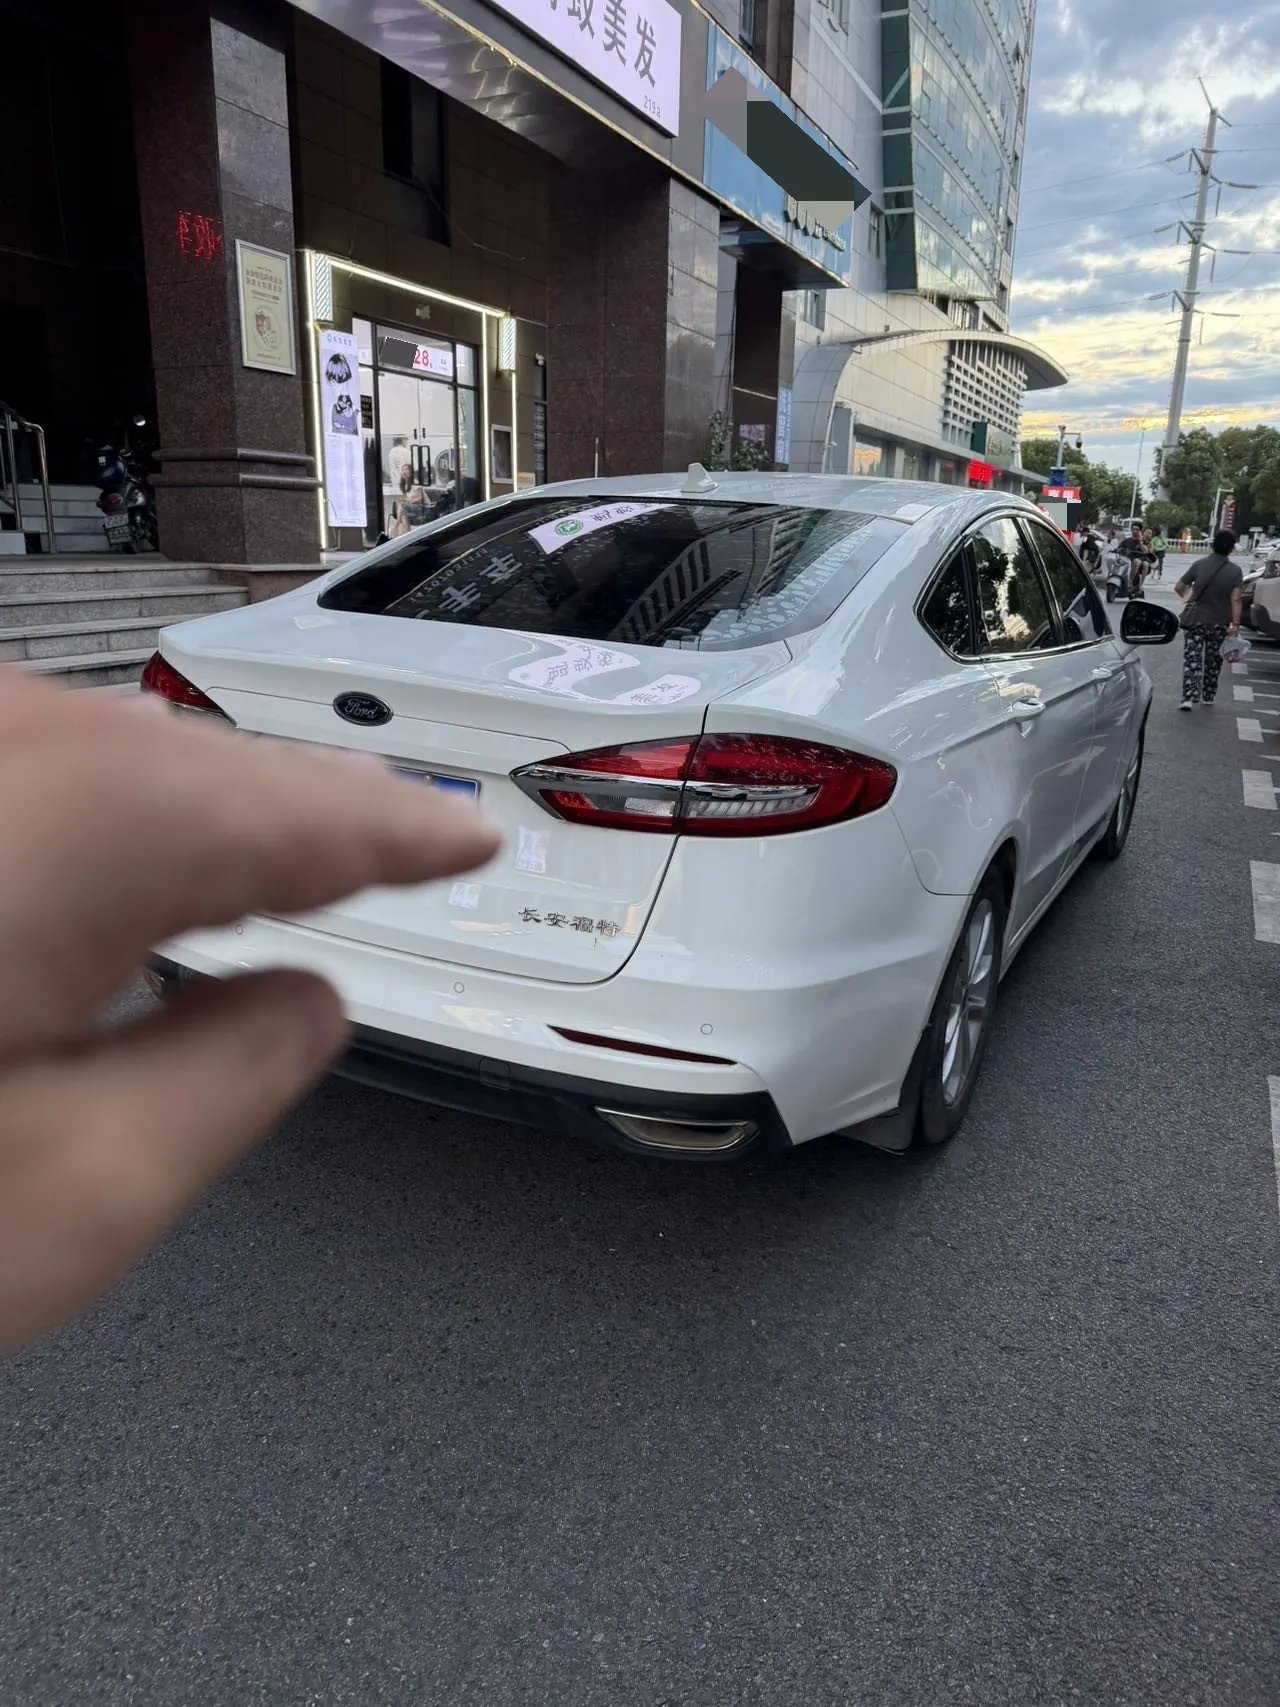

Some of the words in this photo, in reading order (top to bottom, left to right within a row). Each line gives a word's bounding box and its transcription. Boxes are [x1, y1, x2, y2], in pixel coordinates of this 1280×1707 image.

[547, 0, 657, 88] 美发
[414, 349, 429, 367] 28
[344, 699, 379, 719] Ford
[518, 907, 622, 937] 长安福特
